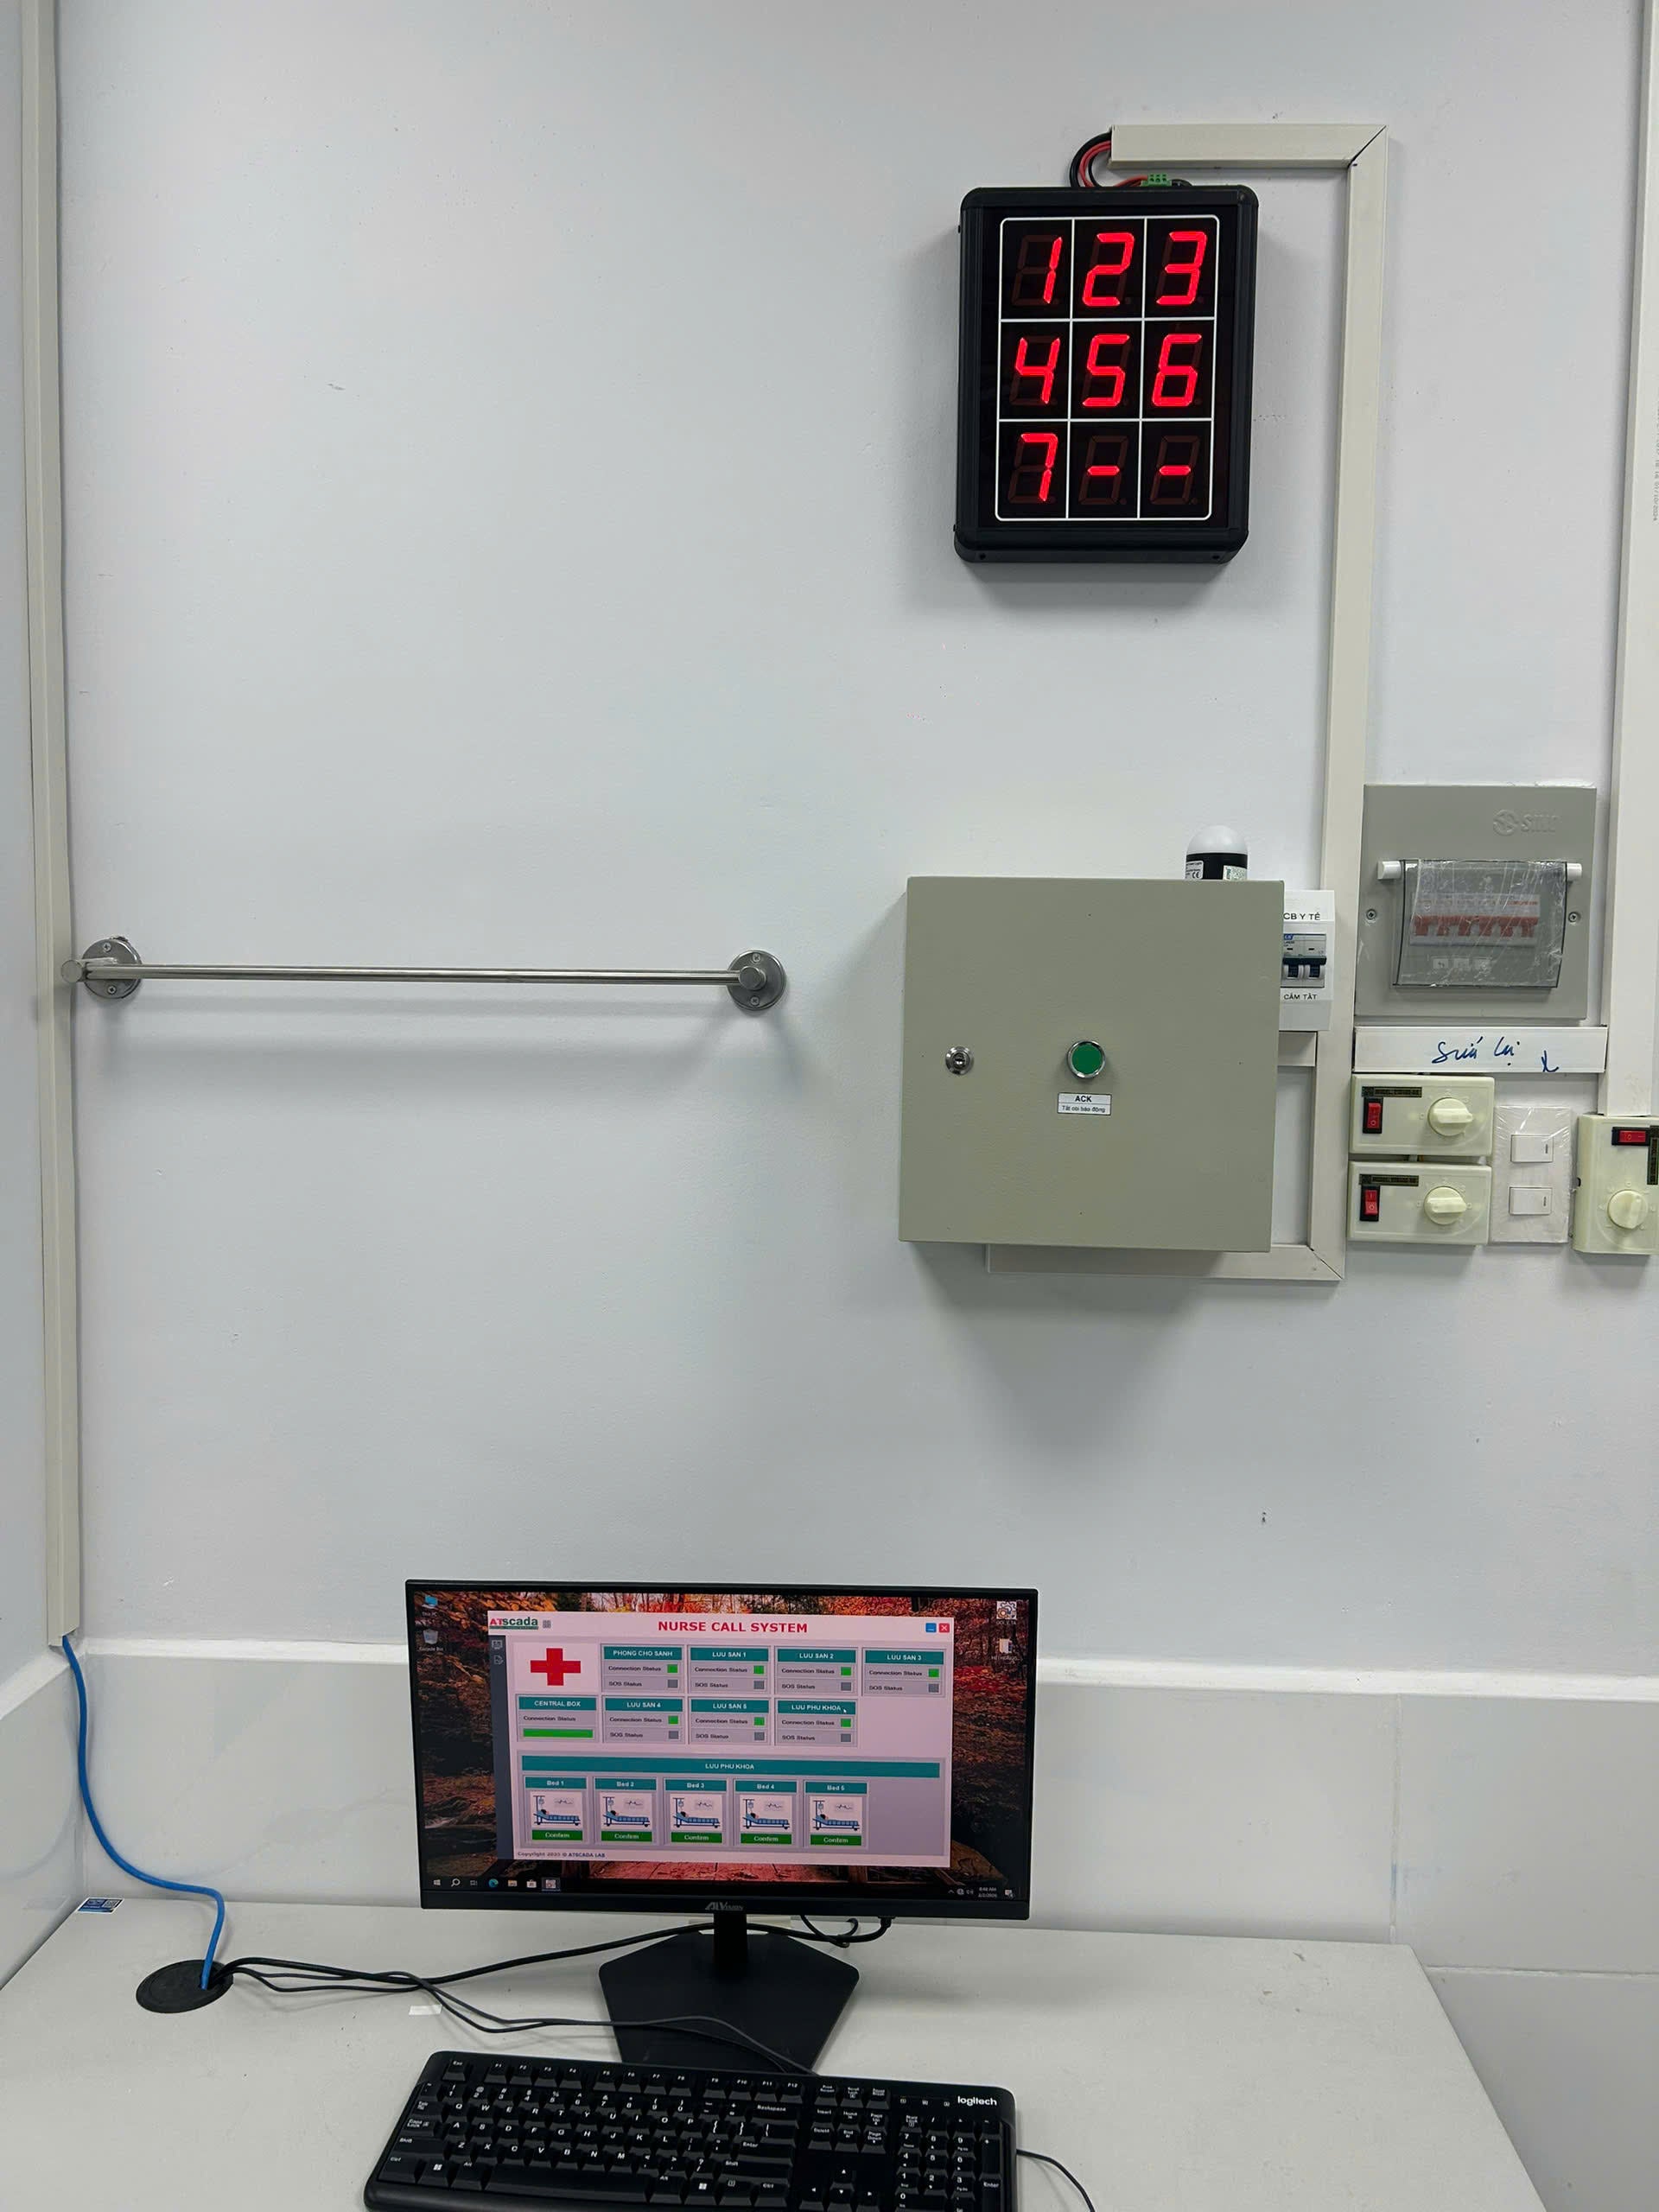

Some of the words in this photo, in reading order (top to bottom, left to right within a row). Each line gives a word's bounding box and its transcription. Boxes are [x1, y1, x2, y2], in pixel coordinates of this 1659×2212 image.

[1043, 236, 1063, 304] 1
[1083, 232, 1135, 306] 2
[1156, 231, 1207, 305] 3
[1015, 337, 1060, 405] 4
[1083, 334, 1130, 407] 5
[1152, 334, 1202, 407] 6
[1020, 433, 1058, 501] 7
[658, 1621, 707, 1631] NURSE
[711, 1622, 747, 1632] CALL
[750, 1623, 808, 1633] SYSTEM
[957, 2095, 998, 2107] logitech
